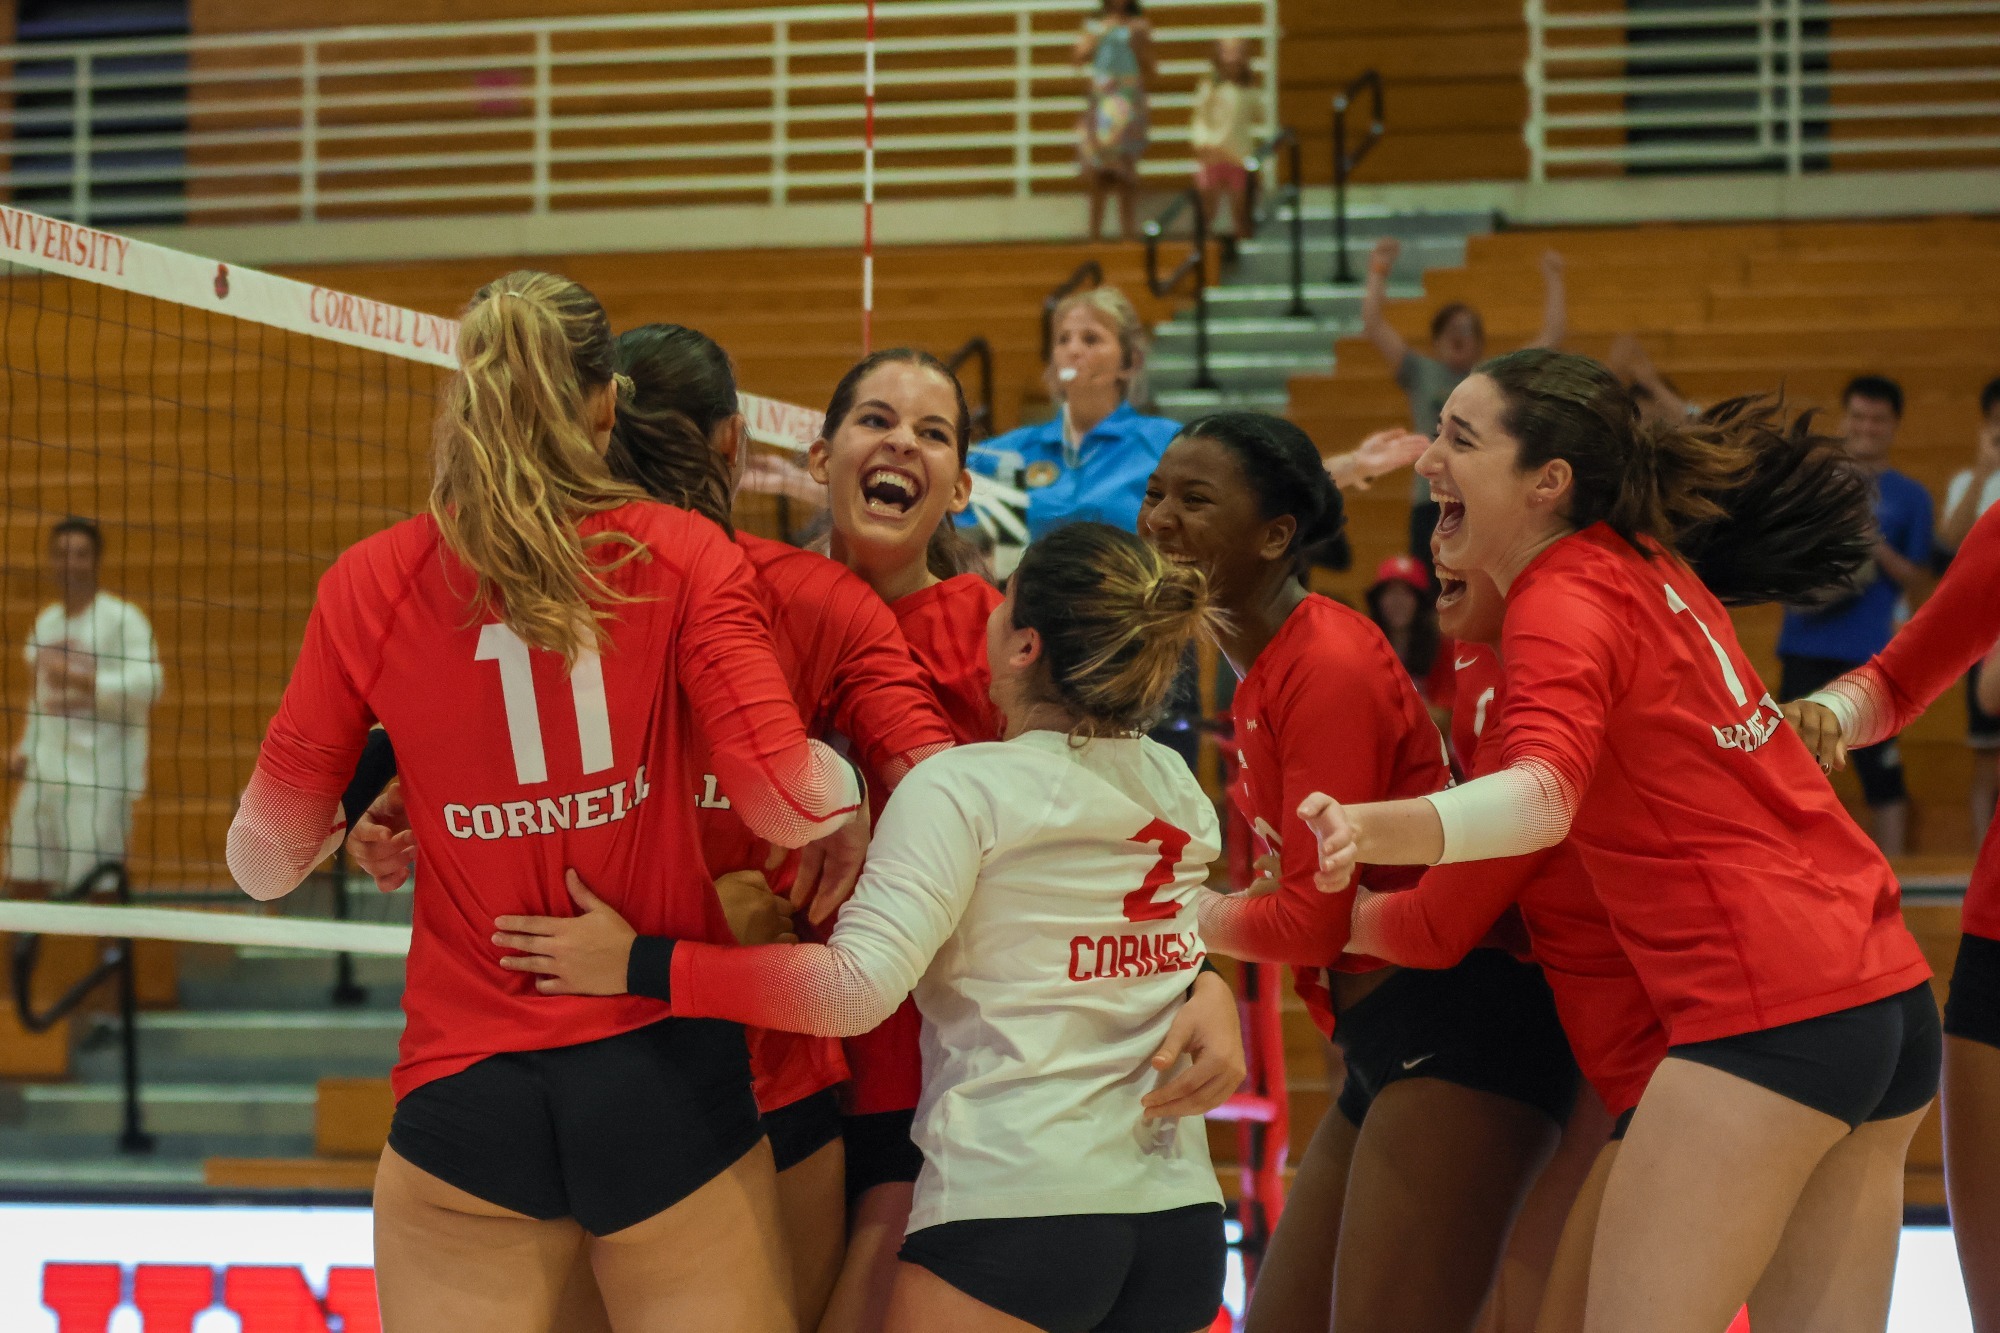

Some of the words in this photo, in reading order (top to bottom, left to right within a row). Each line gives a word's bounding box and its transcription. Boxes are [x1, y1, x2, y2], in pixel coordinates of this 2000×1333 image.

[0, 207, 130, 276] NIVERSITY
[310, 285, 406, 344] CORNELL
[412, 310, 458, 356] UNI
[473, 621, 615, 785] 11
[1122, 816, 1192, 923] 2
